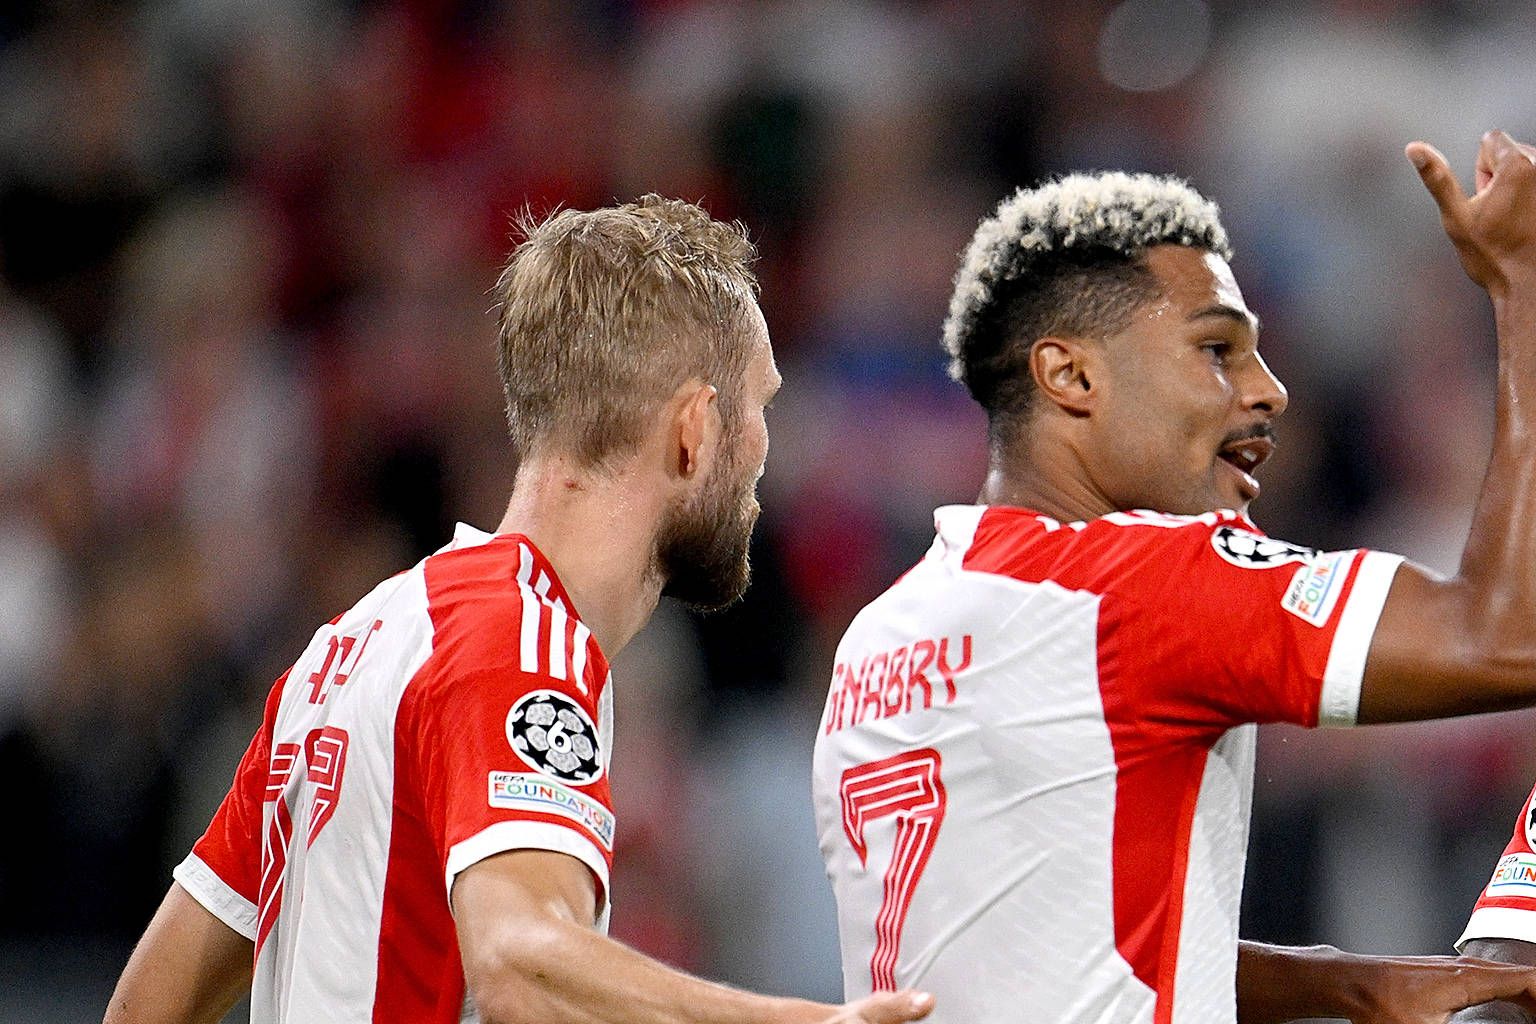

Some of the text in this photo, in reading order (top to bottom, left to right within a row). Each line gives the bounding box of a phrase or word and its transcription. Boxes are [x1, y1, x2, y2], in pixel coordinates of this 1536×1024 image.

[547, 721, 572, 753] 6
[494, 783, 612, 837] FOUNDATION
[840, 747, 945, 992] 7
